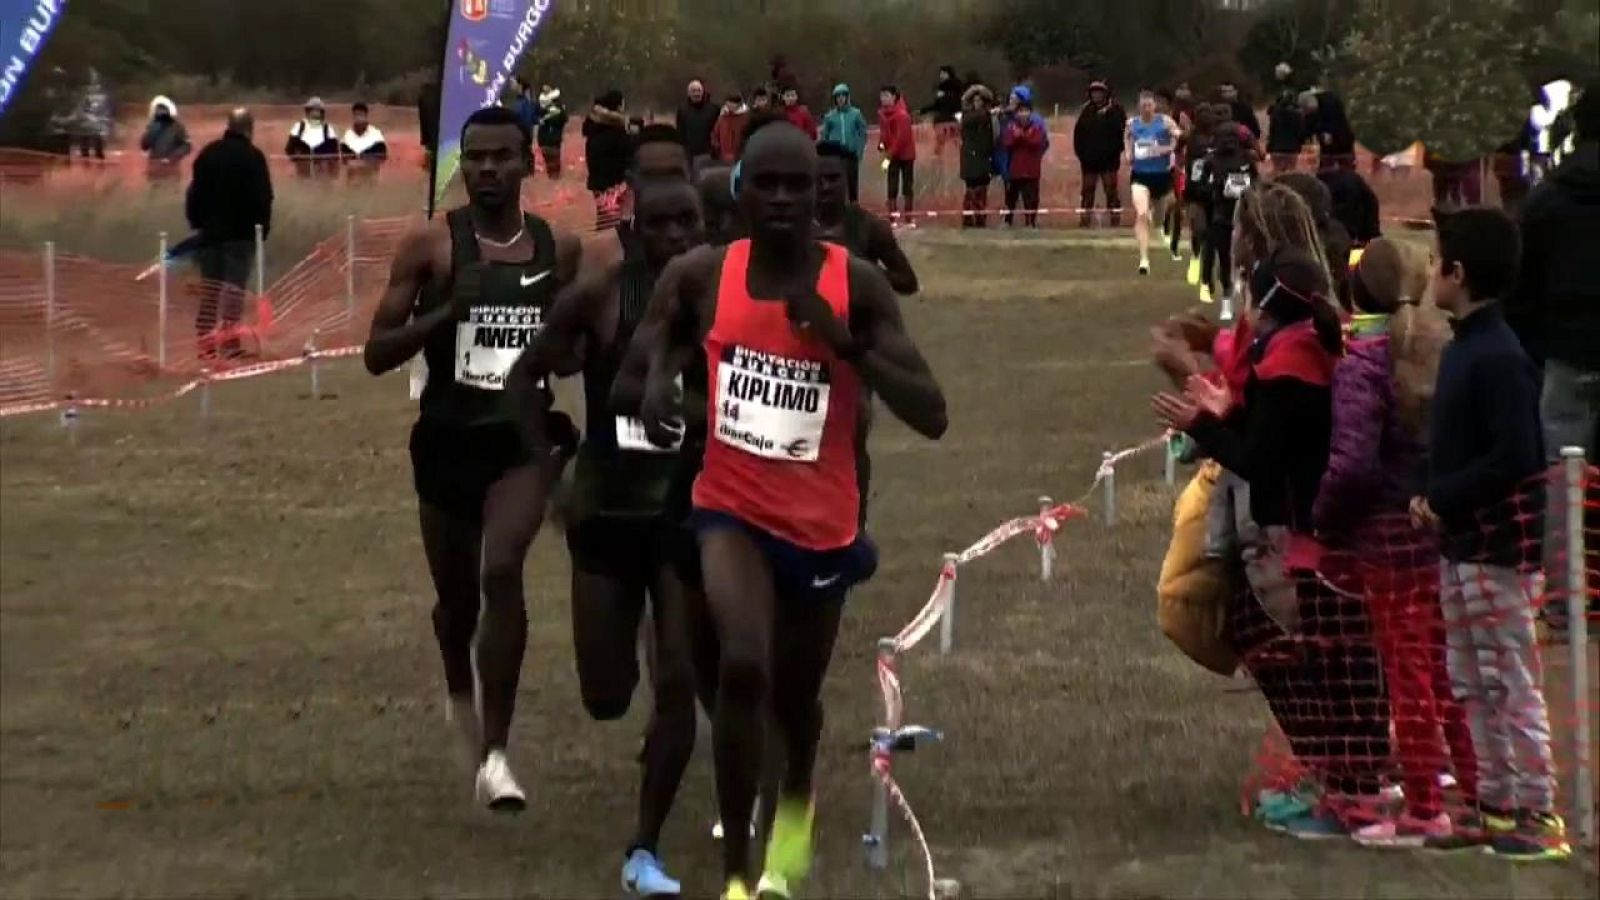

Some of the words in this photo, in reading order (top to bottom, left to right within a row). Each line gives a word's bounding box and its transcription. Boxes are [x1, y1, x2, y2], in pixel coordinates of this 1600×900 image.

[474, 328, 538, 349] AWEK
[728, 370, 819, 413] KIPLIMO
[724, 399, 740, 421] 14
